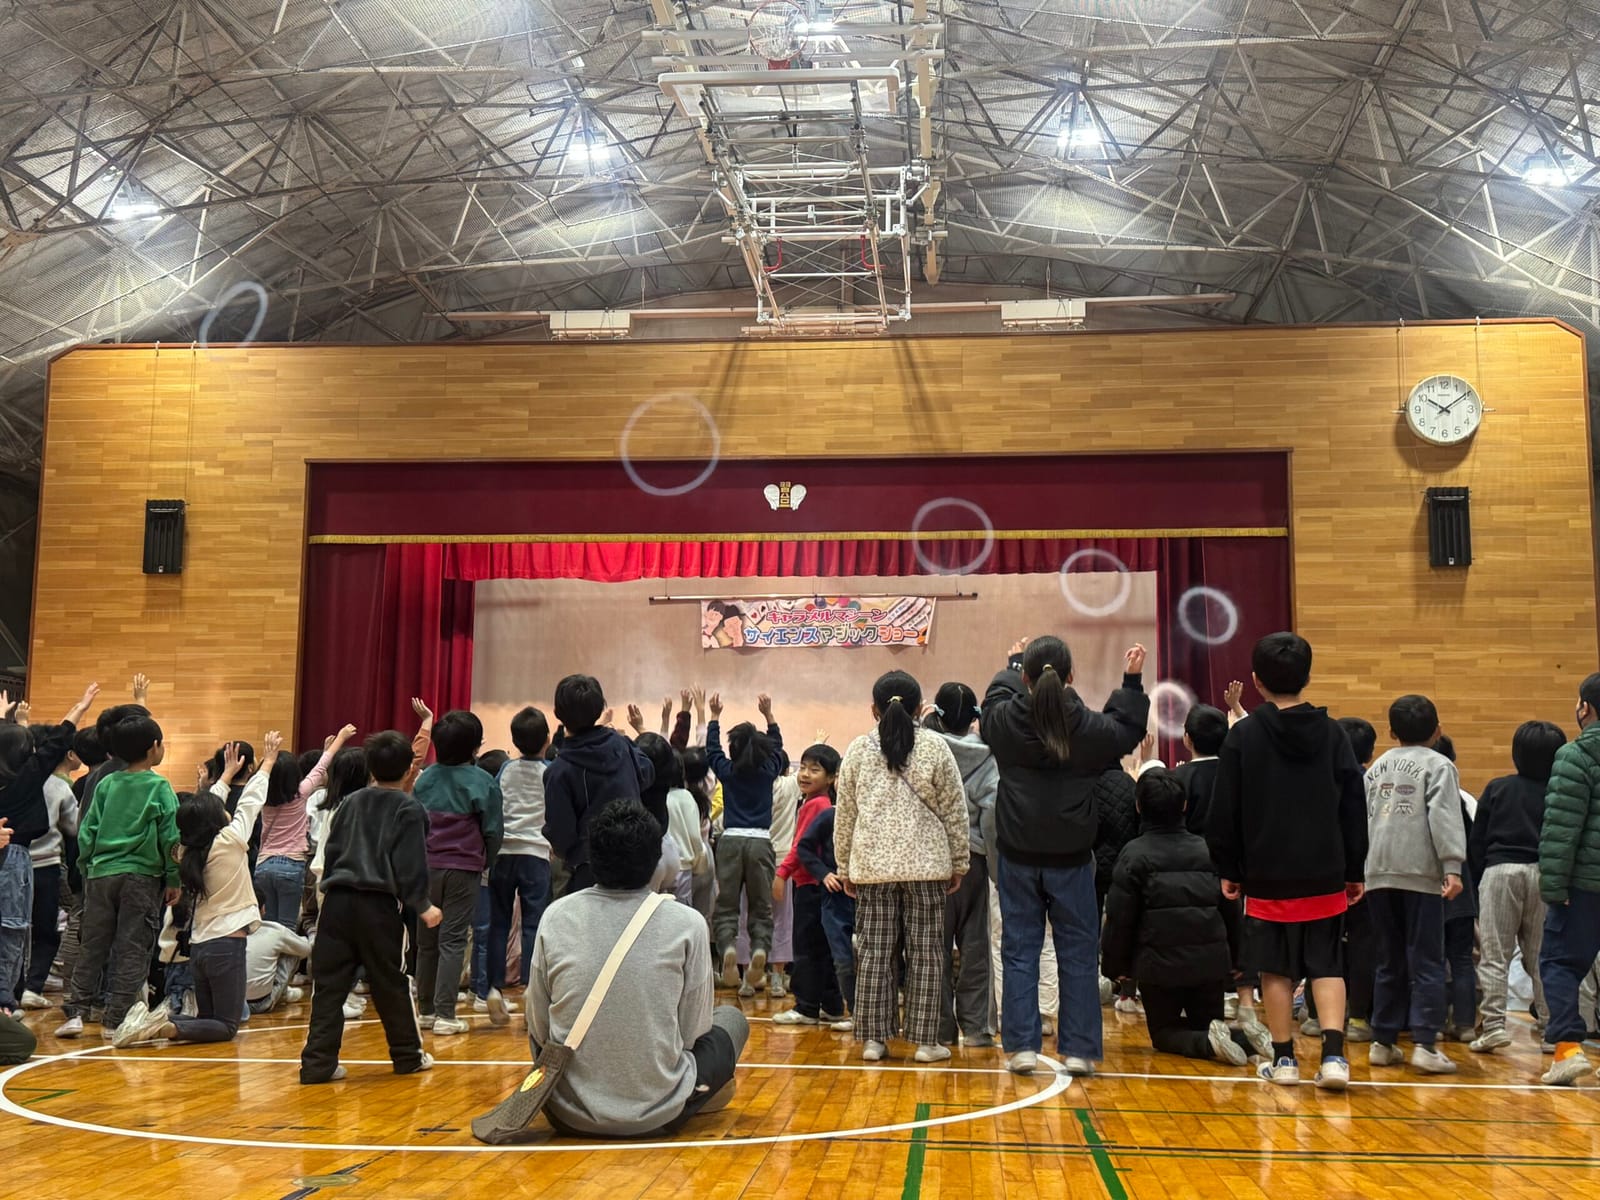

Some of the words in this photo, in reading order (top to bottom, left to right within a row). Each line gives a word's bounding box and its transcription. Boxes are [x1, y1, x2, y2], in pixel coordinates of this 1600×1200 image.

[1427, 384, 1435, 393] 11
[1440, 380, 1449, 390] 12
[1418, 394, 1428, 402] 10
[1414, 405, 1421, 414] 9
[1467, 405, 1474, 414] 3
[1419, 418, 1425, 426] 8
[1464, 418, 1470, 426] 4
[1430, 427, 1436, 435] 7
[1441, 430, 1448, 438] 6
[1454, 426, 1461, 435] 5
[766, 608, 888, 624] キャラメルマシーン
[744, 623, 919, 645] サイエンスマジックショー
[1368, 760, 1388, 784] NEW
